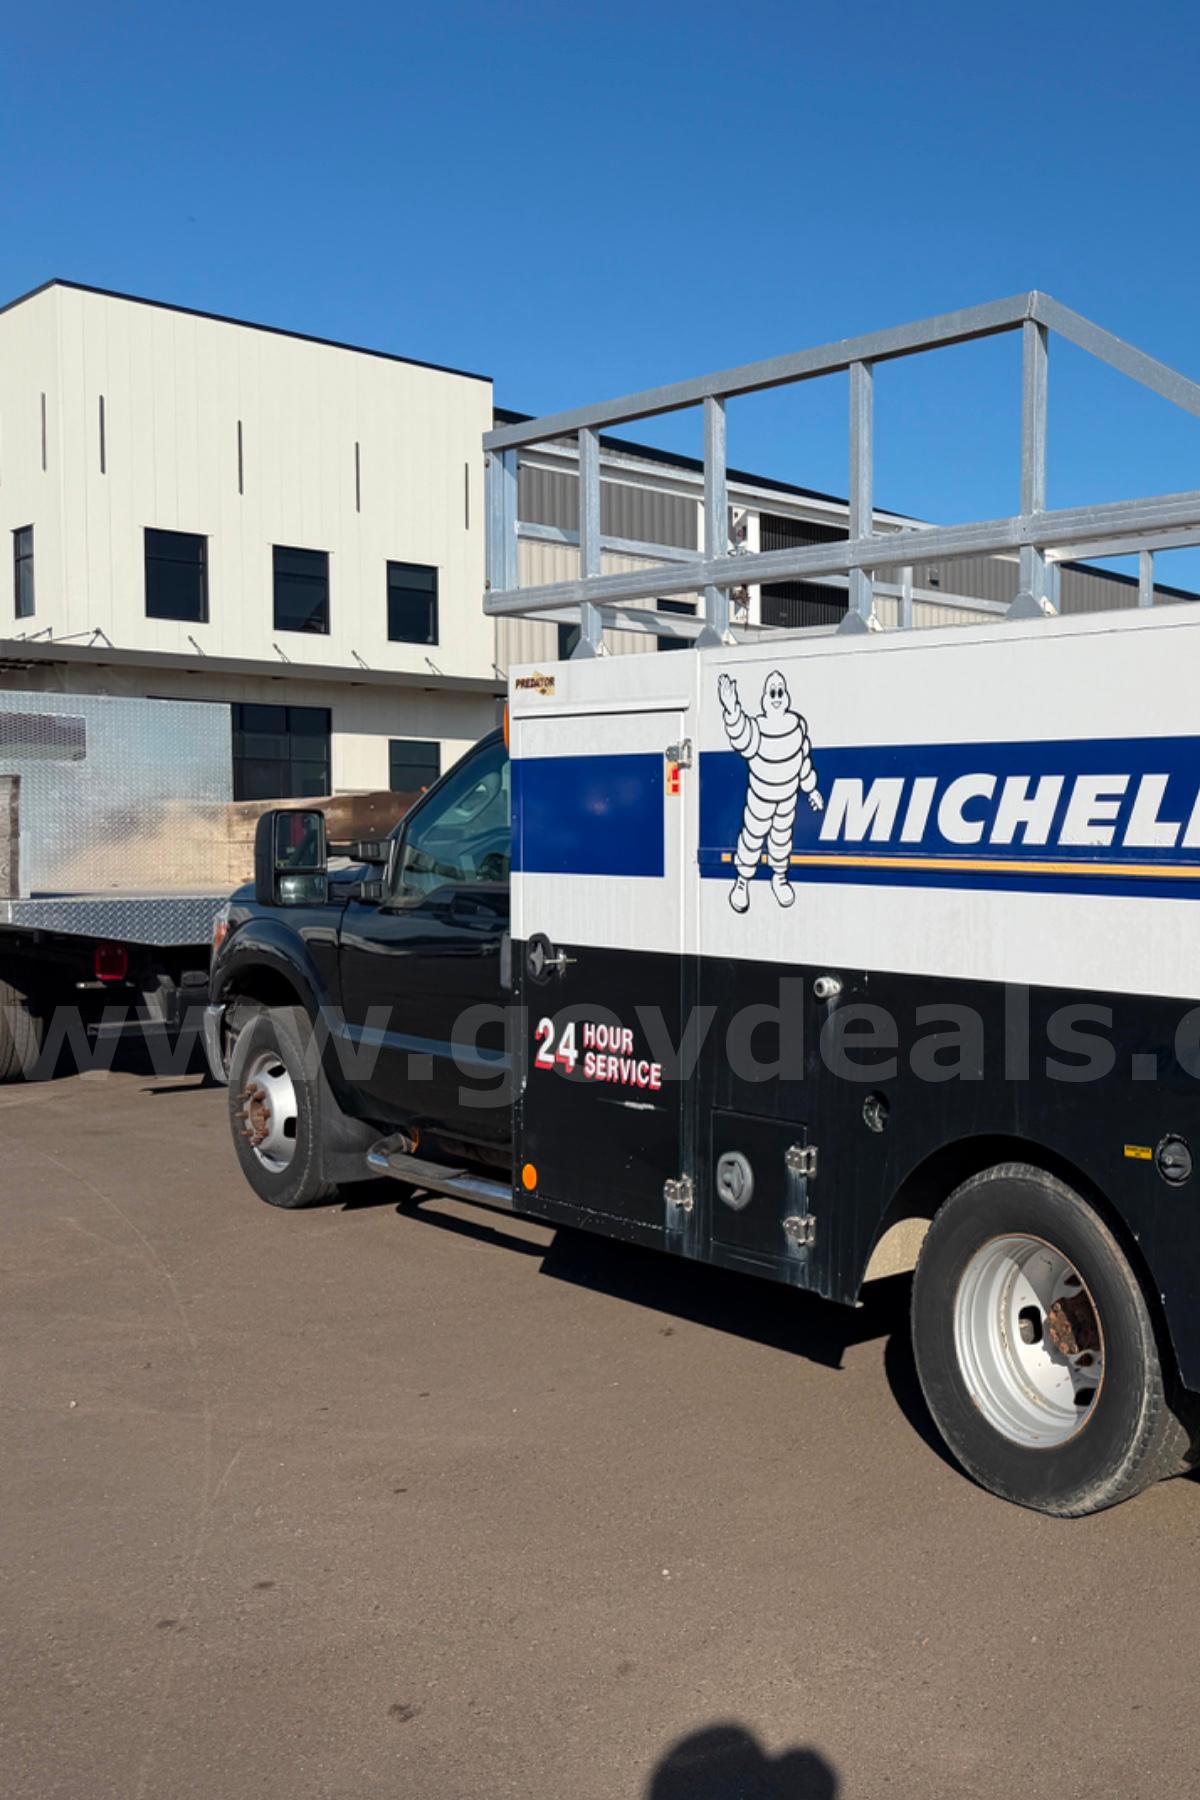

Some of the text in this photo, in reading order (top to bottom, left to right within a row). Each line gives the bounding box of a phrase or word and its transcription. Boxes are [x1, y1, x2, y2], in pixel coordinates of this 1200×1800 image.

[515, 676, 555, 689] PREDATOR
[534, 1017, 634, 1073] 24 HOUR
[583, 1052, 662, 1091] SERVICE
